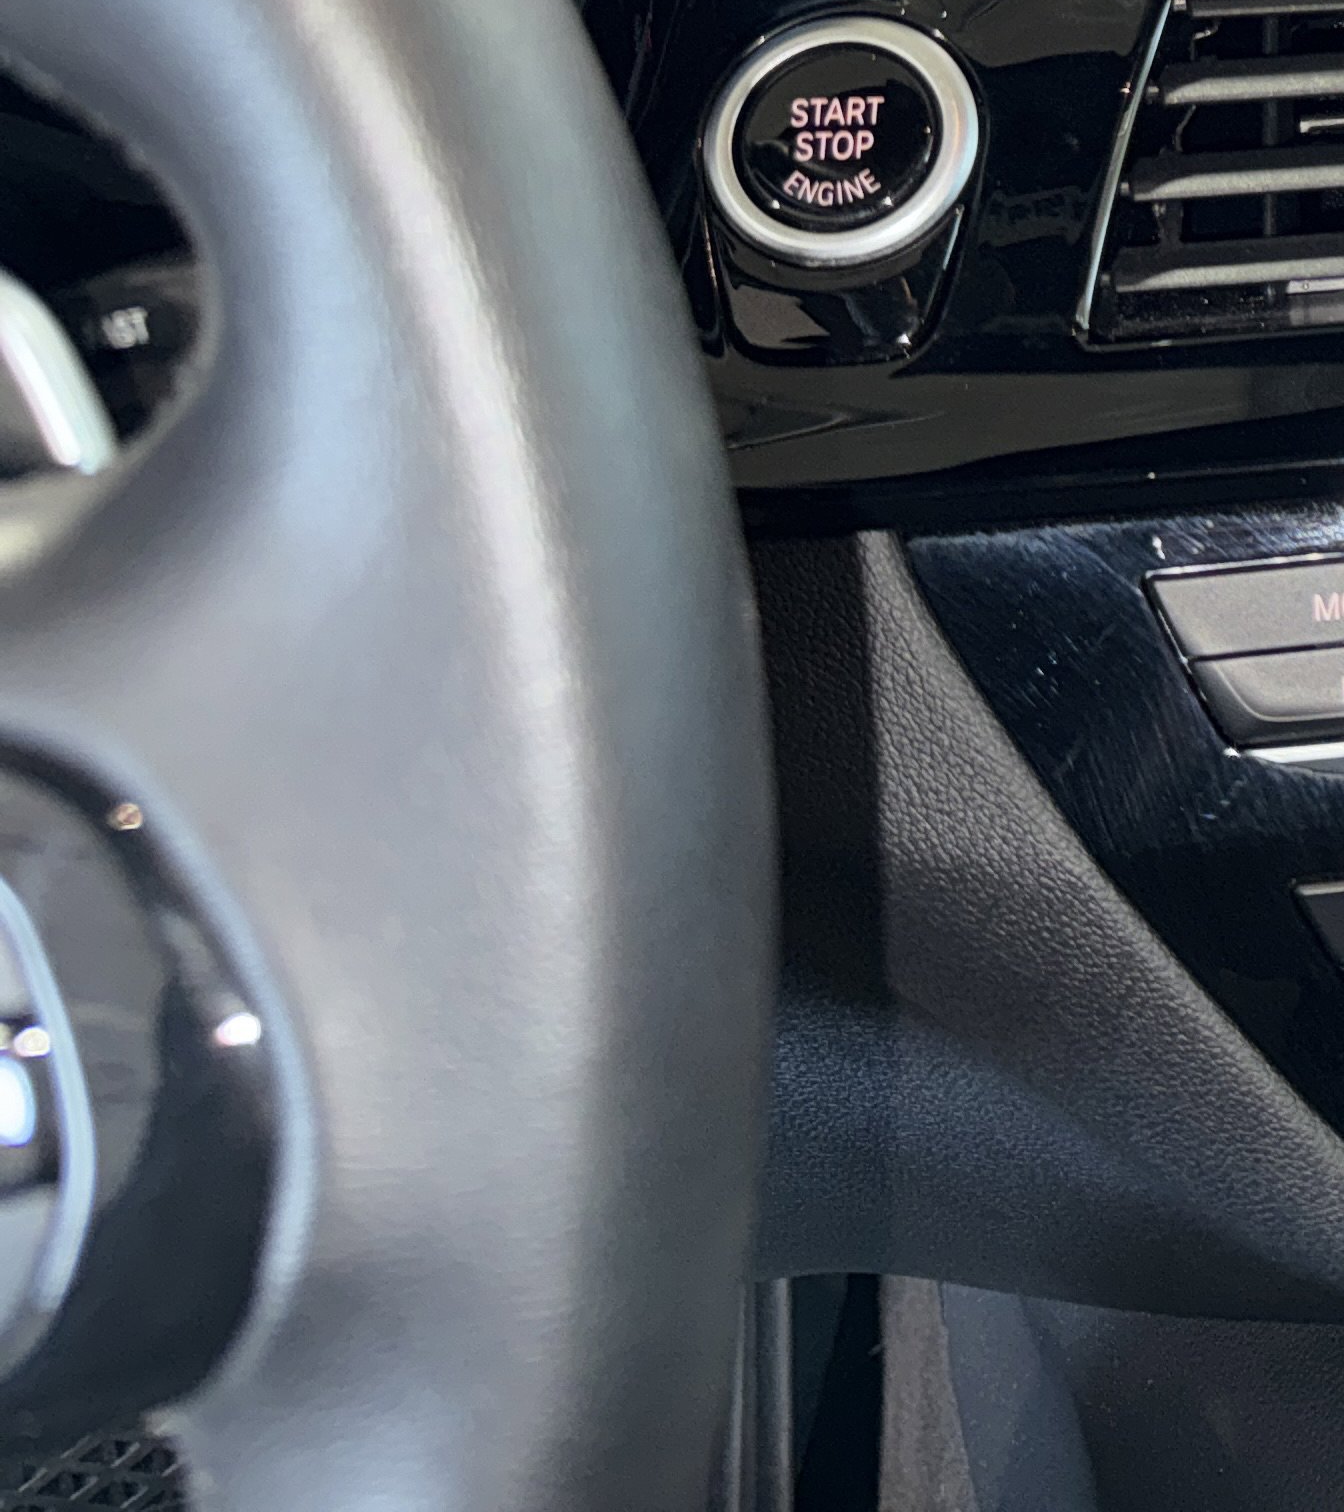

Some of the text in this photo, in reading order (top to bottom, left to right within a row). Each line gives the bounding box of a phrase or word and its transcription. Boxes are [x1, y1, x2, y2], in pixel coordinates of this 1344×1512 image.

[790, 95, 886, 128] START
[793, 129, 875, 162] STOP
[782, 167, 882, 206] ENGINE
